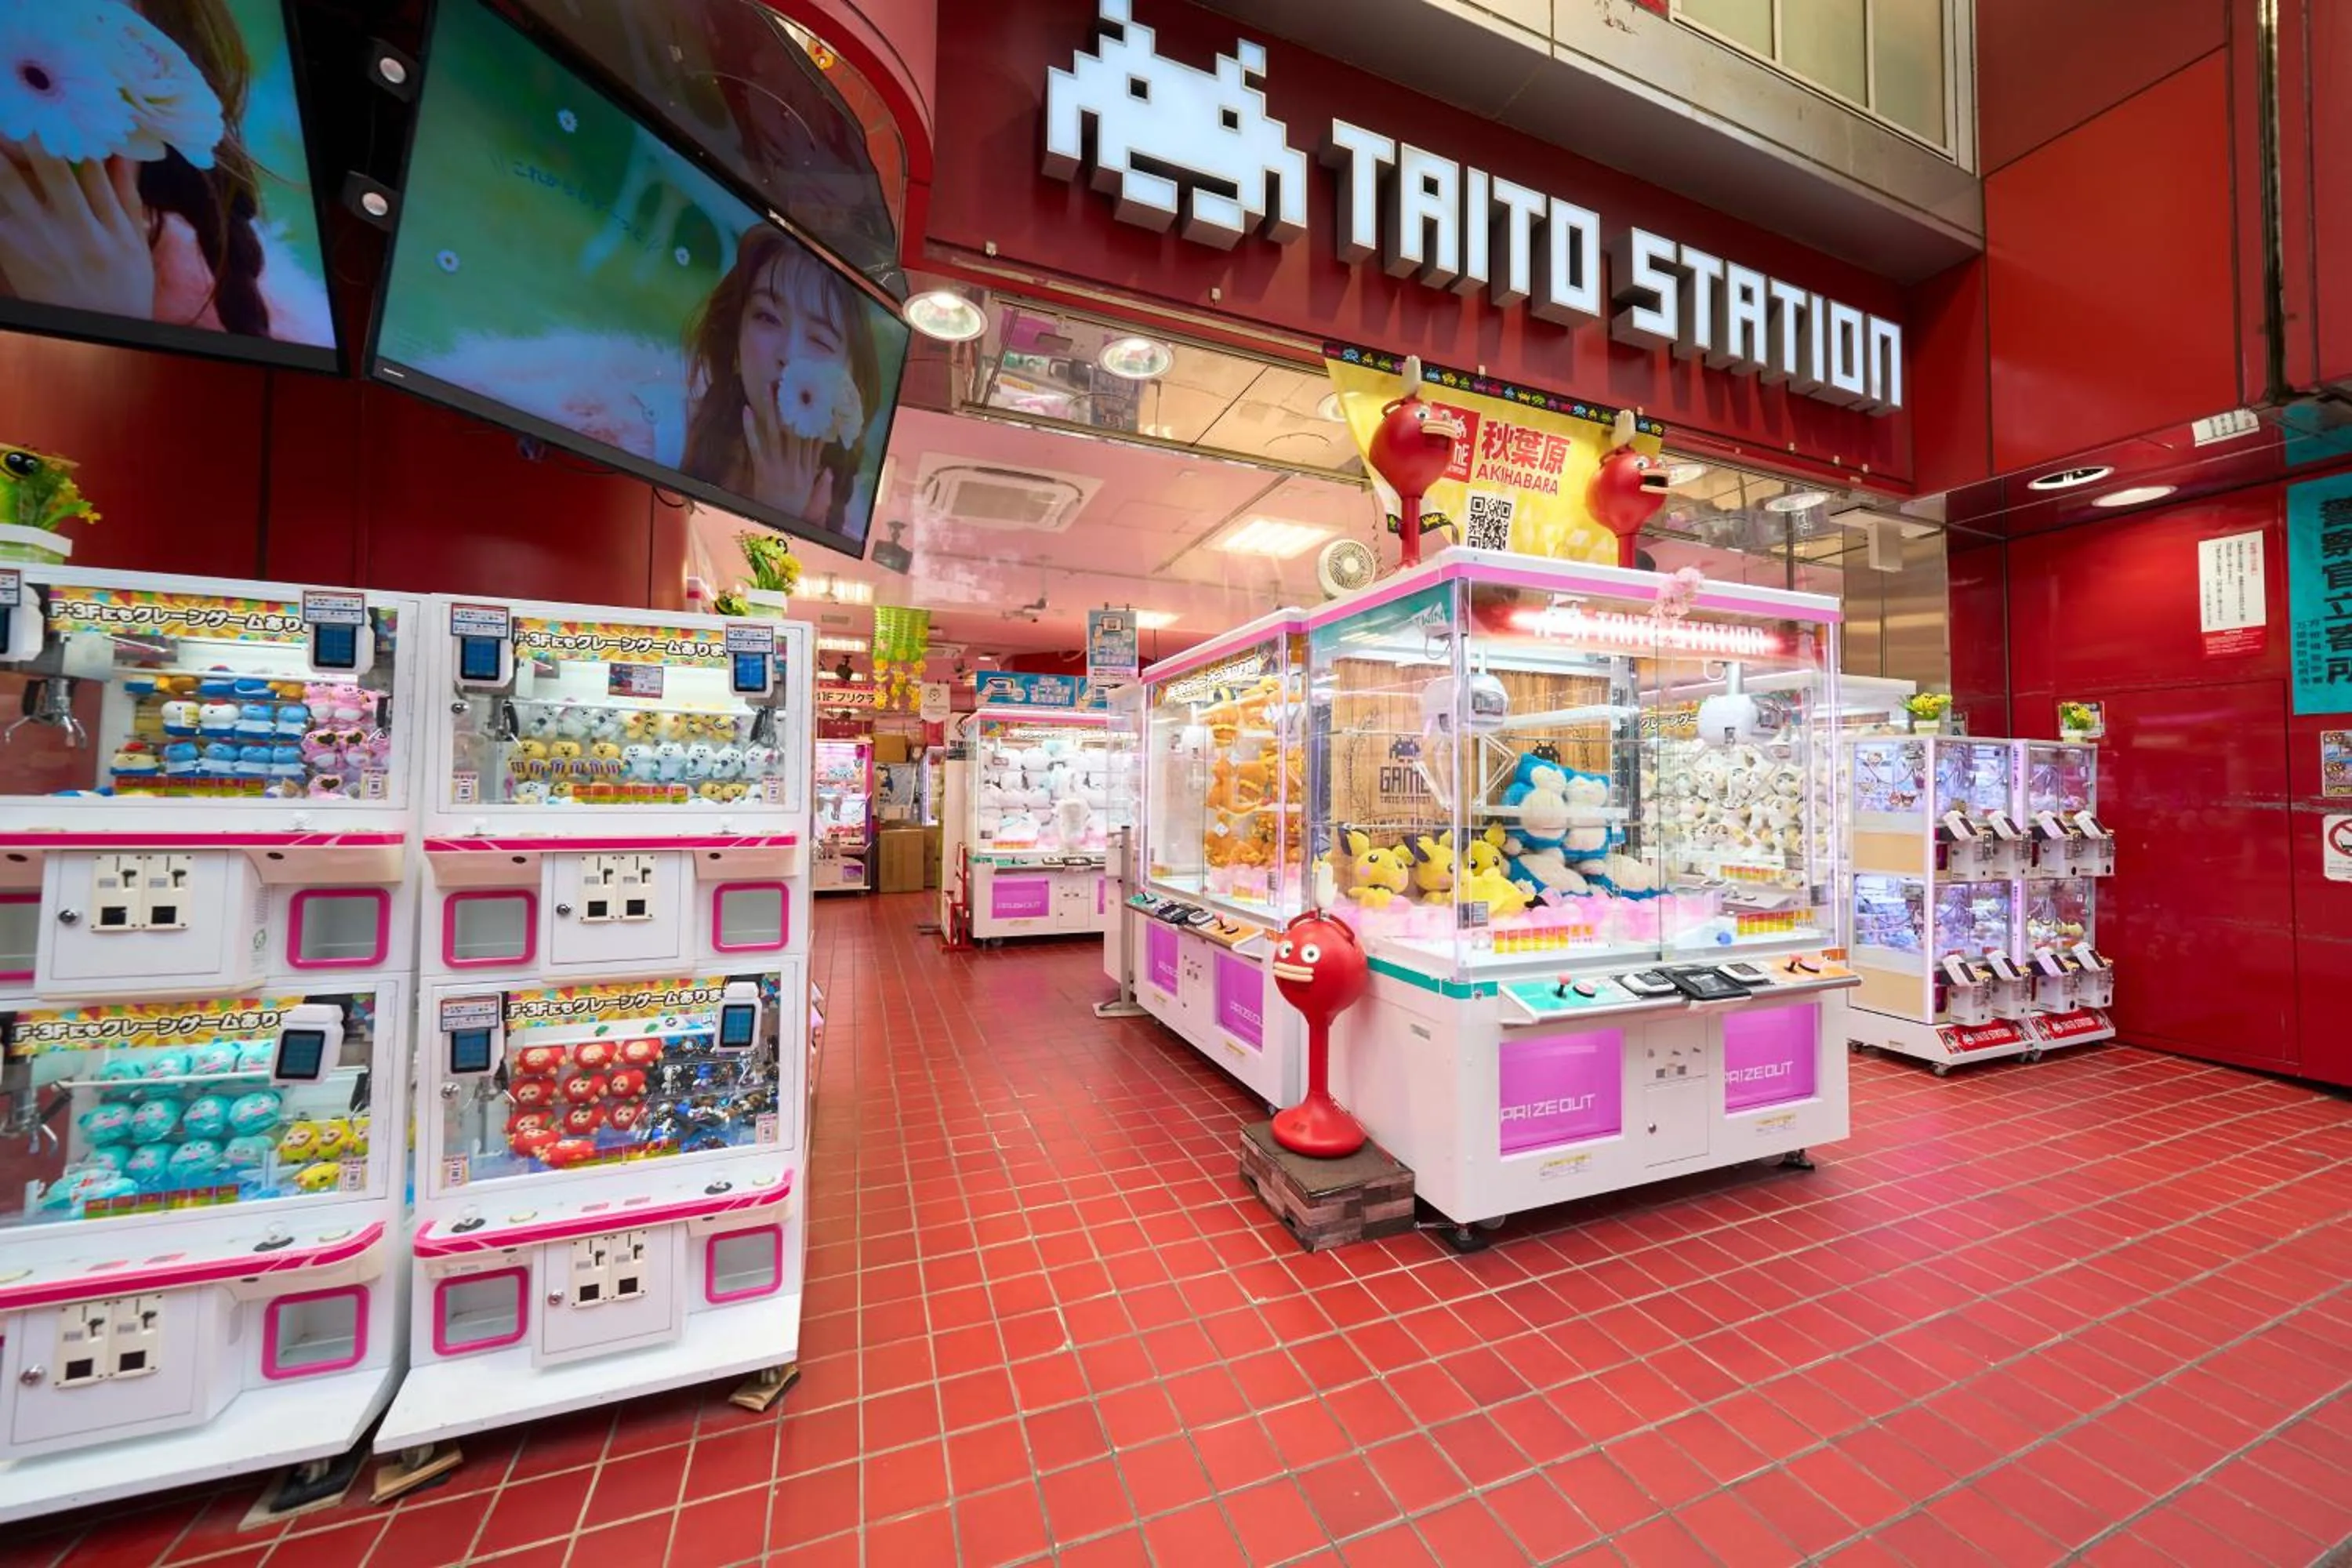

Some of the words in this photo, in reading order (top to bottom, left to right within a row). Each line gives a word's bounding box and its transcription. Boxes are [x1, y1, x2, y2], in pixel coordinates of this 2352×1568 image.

[1332, 118, 1601, 317] TAITO
[1631, 227, 1902, 414] STATION
[1481, 419, 1572, 475] 秋葉原
[1476, 463, 1559, 495] AKIHABARA
[1501, 1093, 1596, 1123] PRIZEOUT
